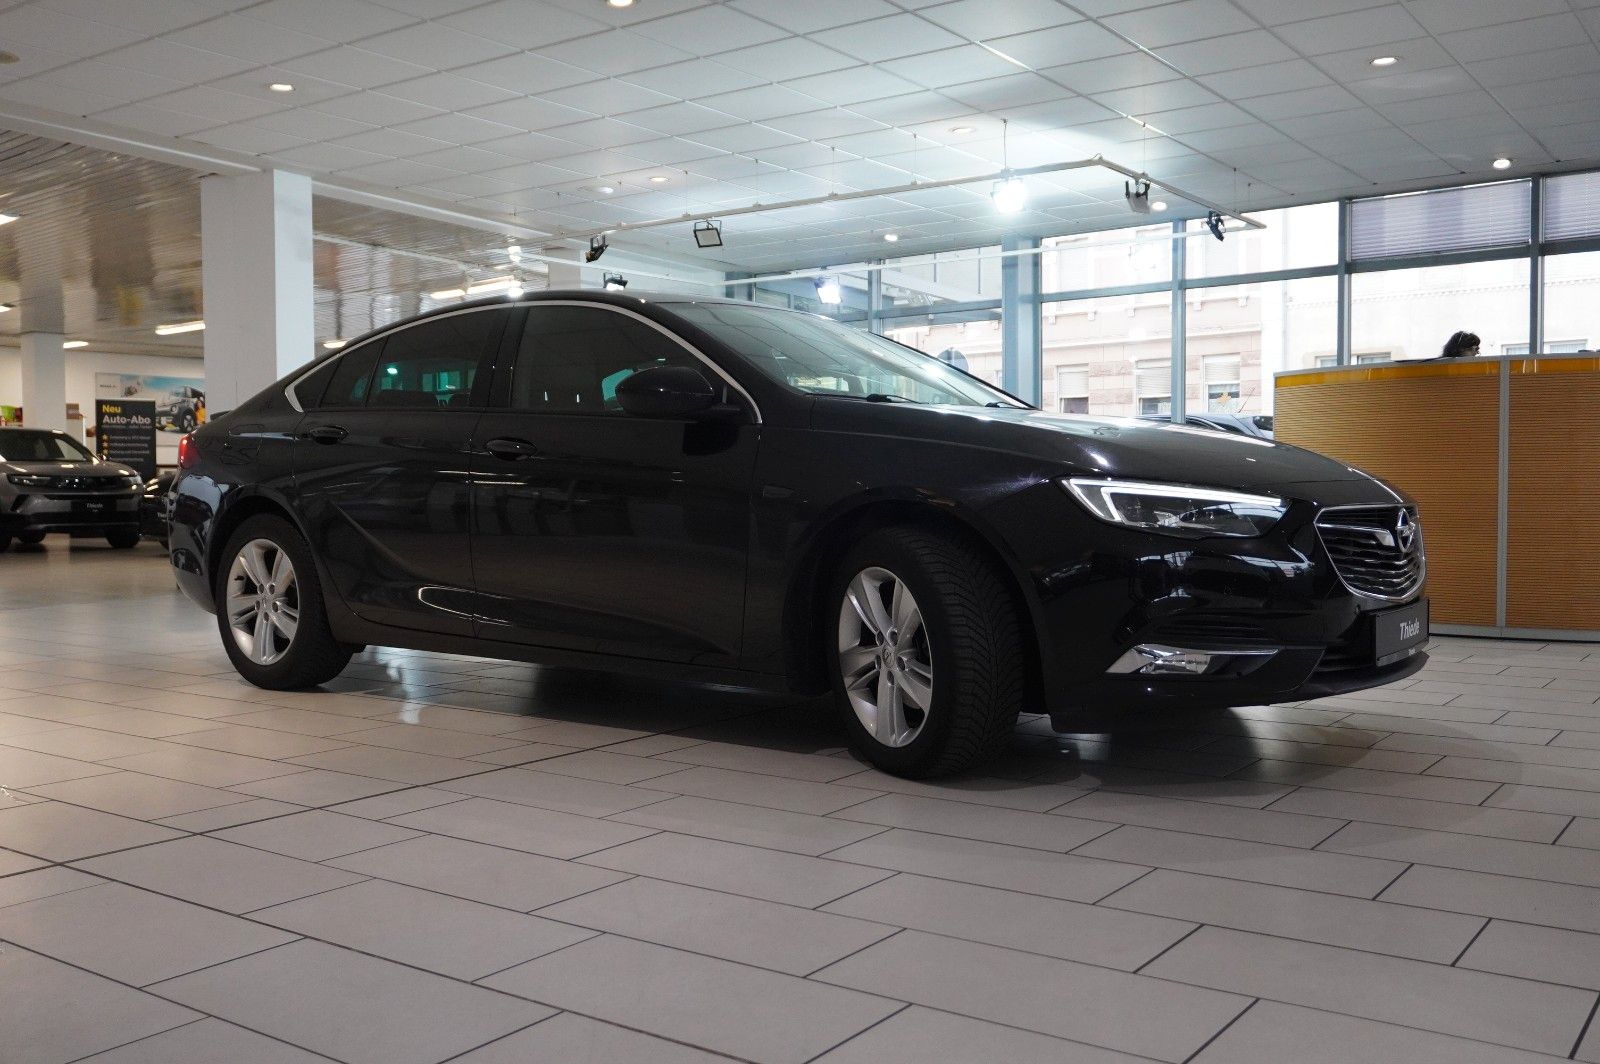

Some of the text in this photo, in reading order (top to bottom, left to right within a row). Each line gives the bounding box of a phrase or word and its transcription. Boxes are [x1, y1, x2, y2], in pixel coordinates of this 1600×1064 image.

[102, 404, 122, 413] Neu
[102, 415, 152, 424] Auto-Abo
[1399, 617, 1420, 641] Thiede
